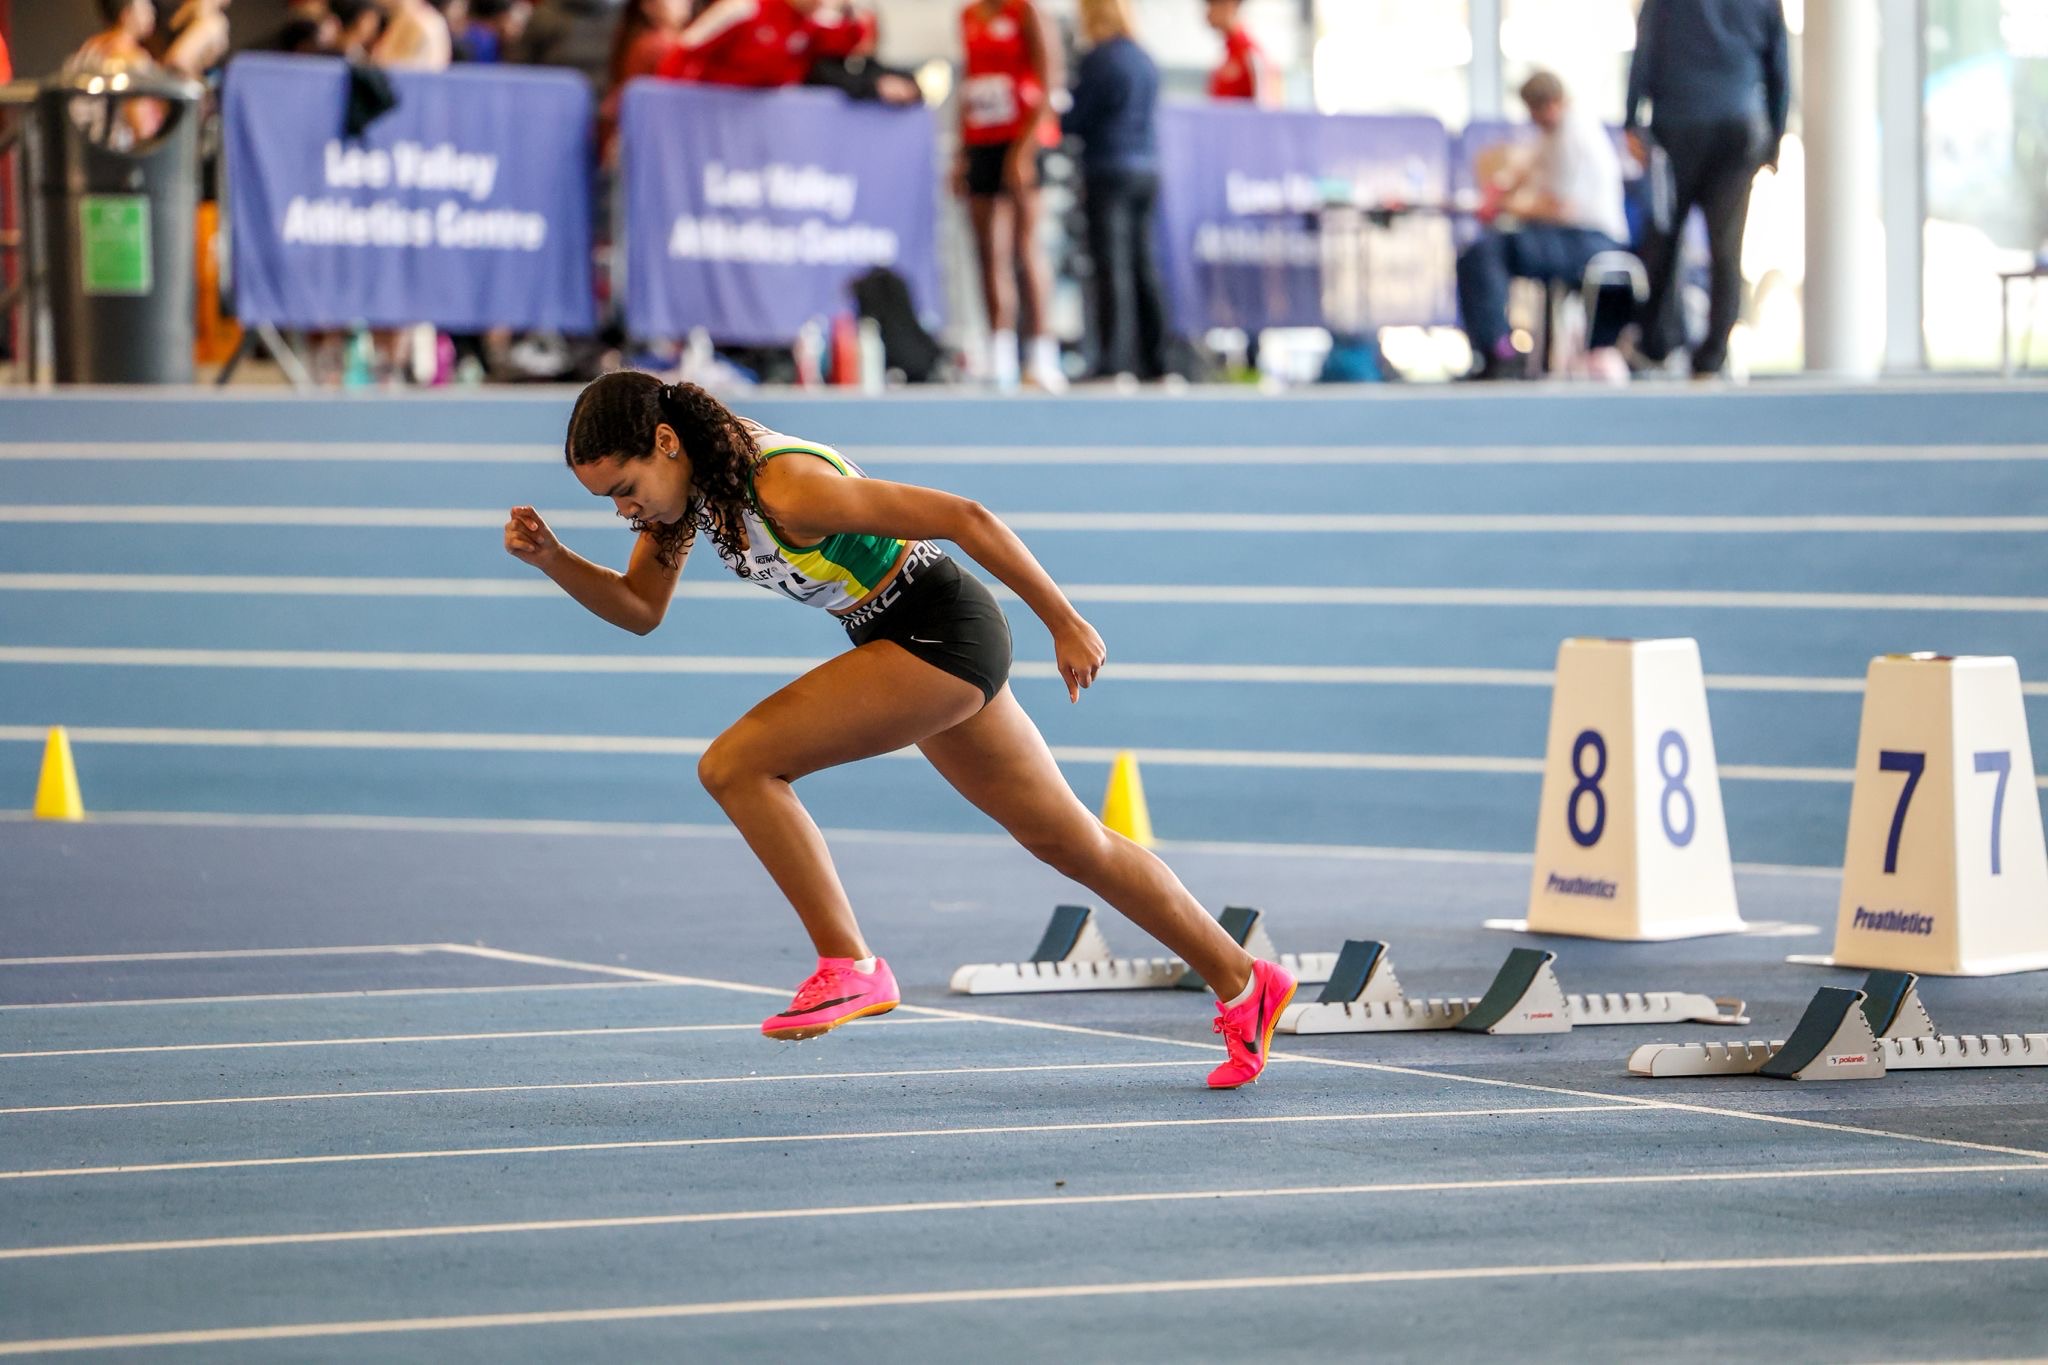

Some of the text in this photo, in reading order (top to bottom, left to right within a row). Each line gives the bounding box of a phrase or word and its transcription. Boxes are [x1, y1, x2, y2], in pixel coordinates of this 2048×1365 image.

[325, 139, 498, 200] Lee Valley
[283, 197, 548, 251] Athletics Centre
[1567, 730, 1607, 848] 8
[1657, 730, 1696, 848] 8
[1879, 750, 1925, 875] 7
[1974, 751, 2011, 875] 7
[1544, 872, 1618, 900] Proathletics
[1852, 905, 1934, 936] Proathletics
[1838, 1055, 1865, 1064] polanik
